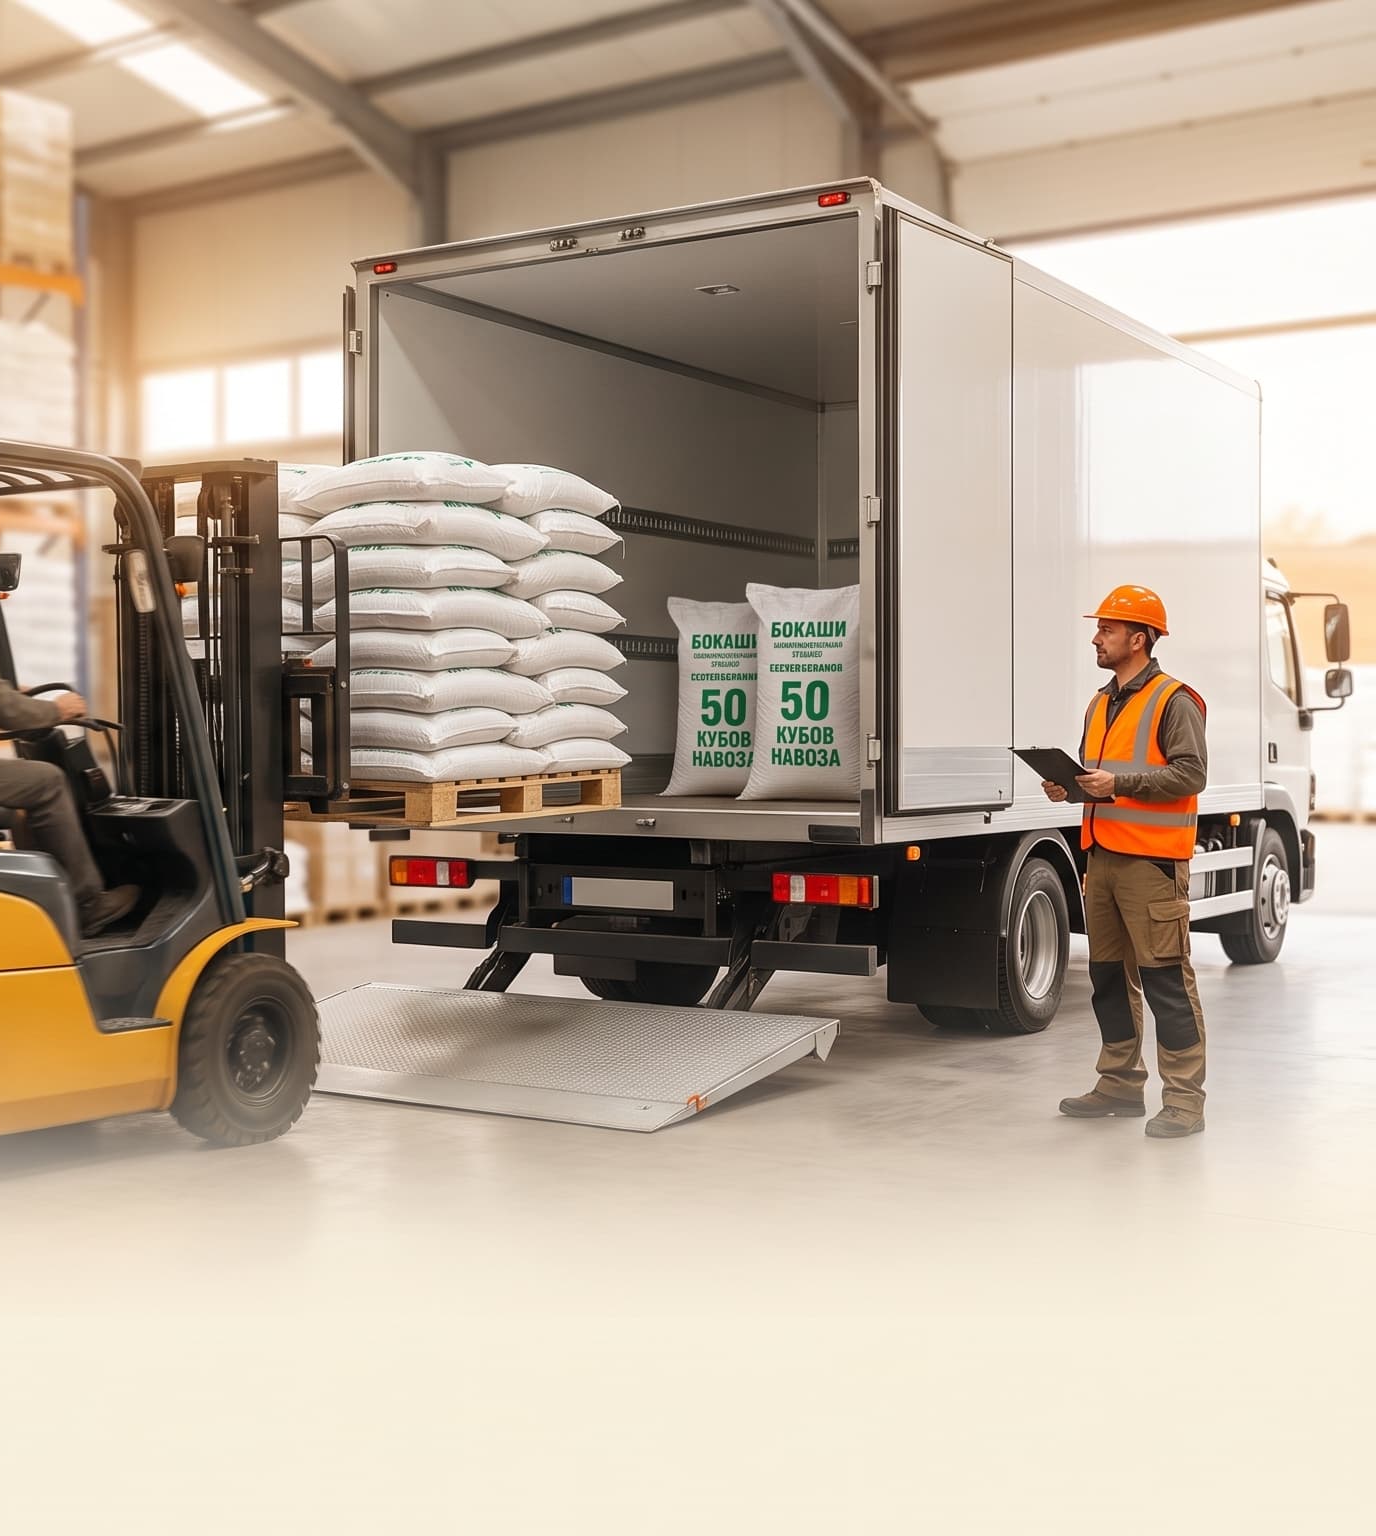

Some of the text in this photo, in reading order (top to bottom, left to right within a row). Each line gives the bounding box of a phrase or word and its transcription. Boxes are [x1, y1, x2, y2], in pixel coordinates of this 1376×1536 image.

[771, 621, 846, 638] БОКАШИ
[701, 688, 747, 727] 50
[780, 680, 830, 721] 50
[697, 730, 752, 748] КУБОВ
[776, 726, 834, 745] КУБОВ
[771, 748, 841, 767] НАВОЗА
